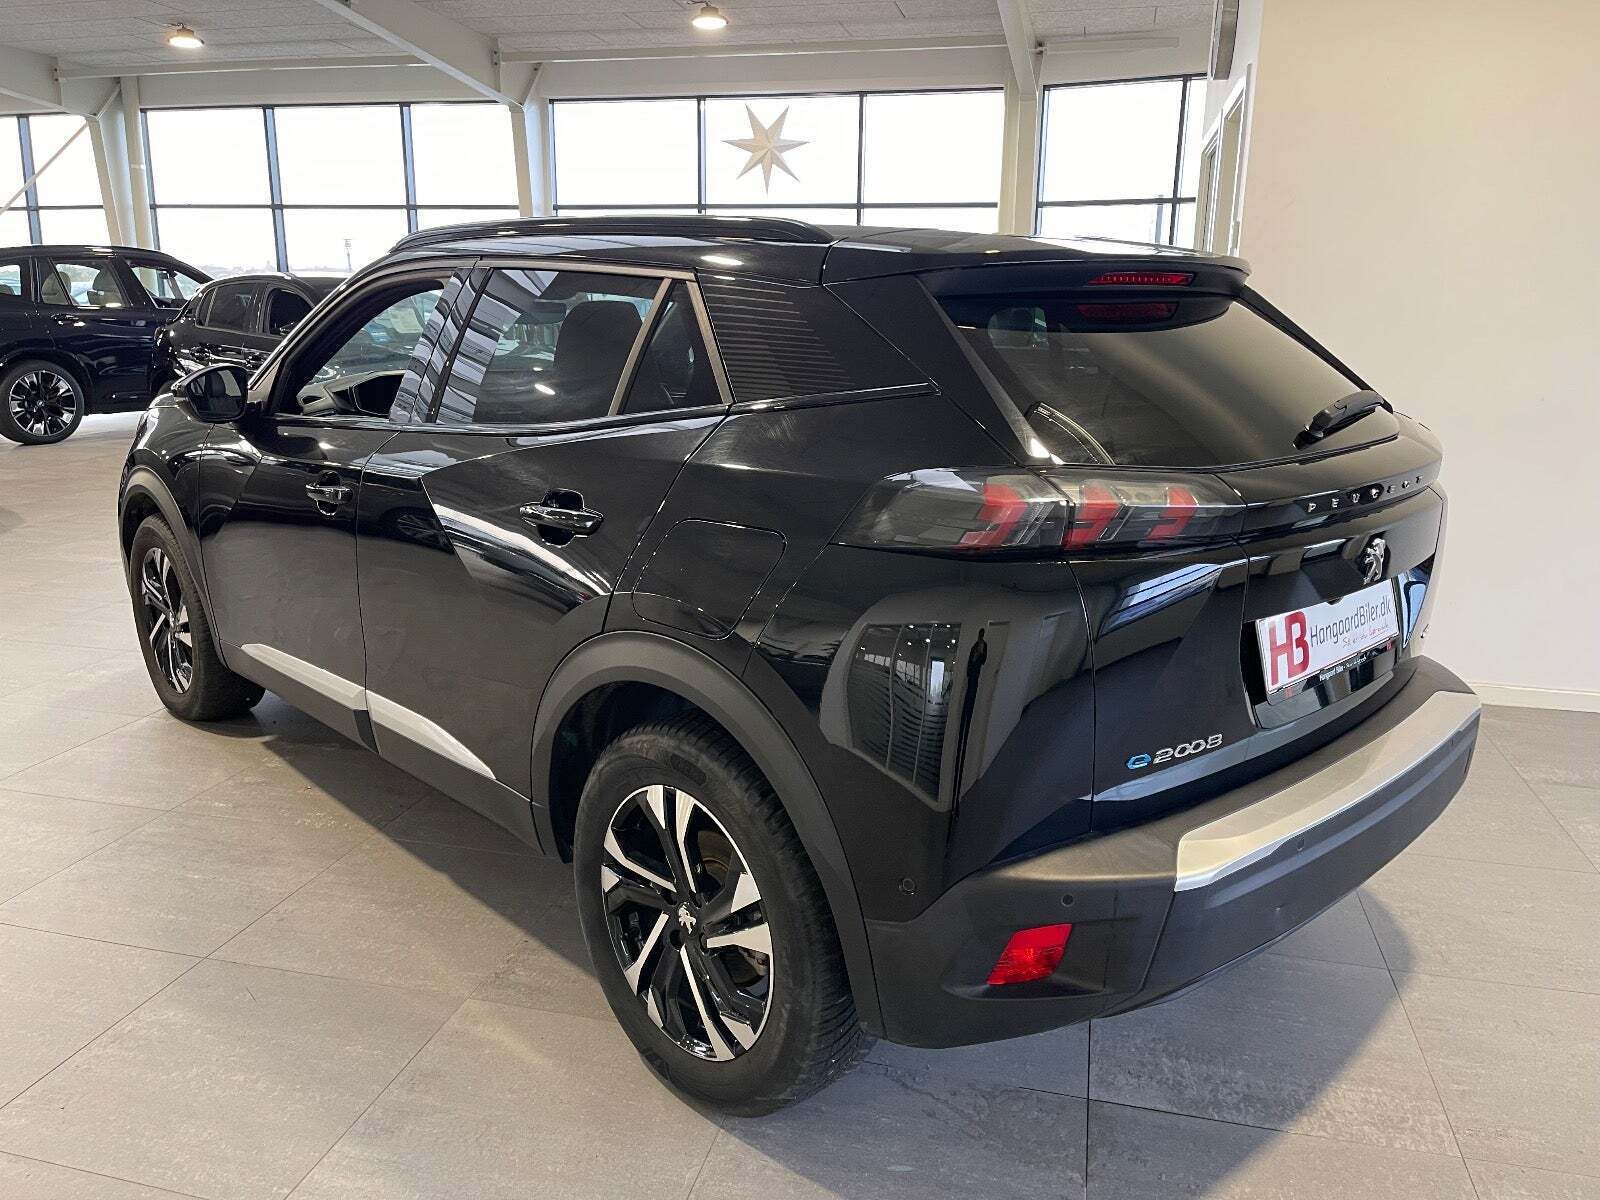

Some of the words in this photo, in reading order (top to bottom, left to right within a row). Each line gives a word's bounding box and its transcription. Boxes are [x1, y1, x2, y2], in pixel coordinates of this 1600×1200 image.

[1307, 475, 1423, 513] PEUGEOT
[1310, 595, 1392, 648] HangaardBiler.dk
[1268, 611, 1310, 686] HB
